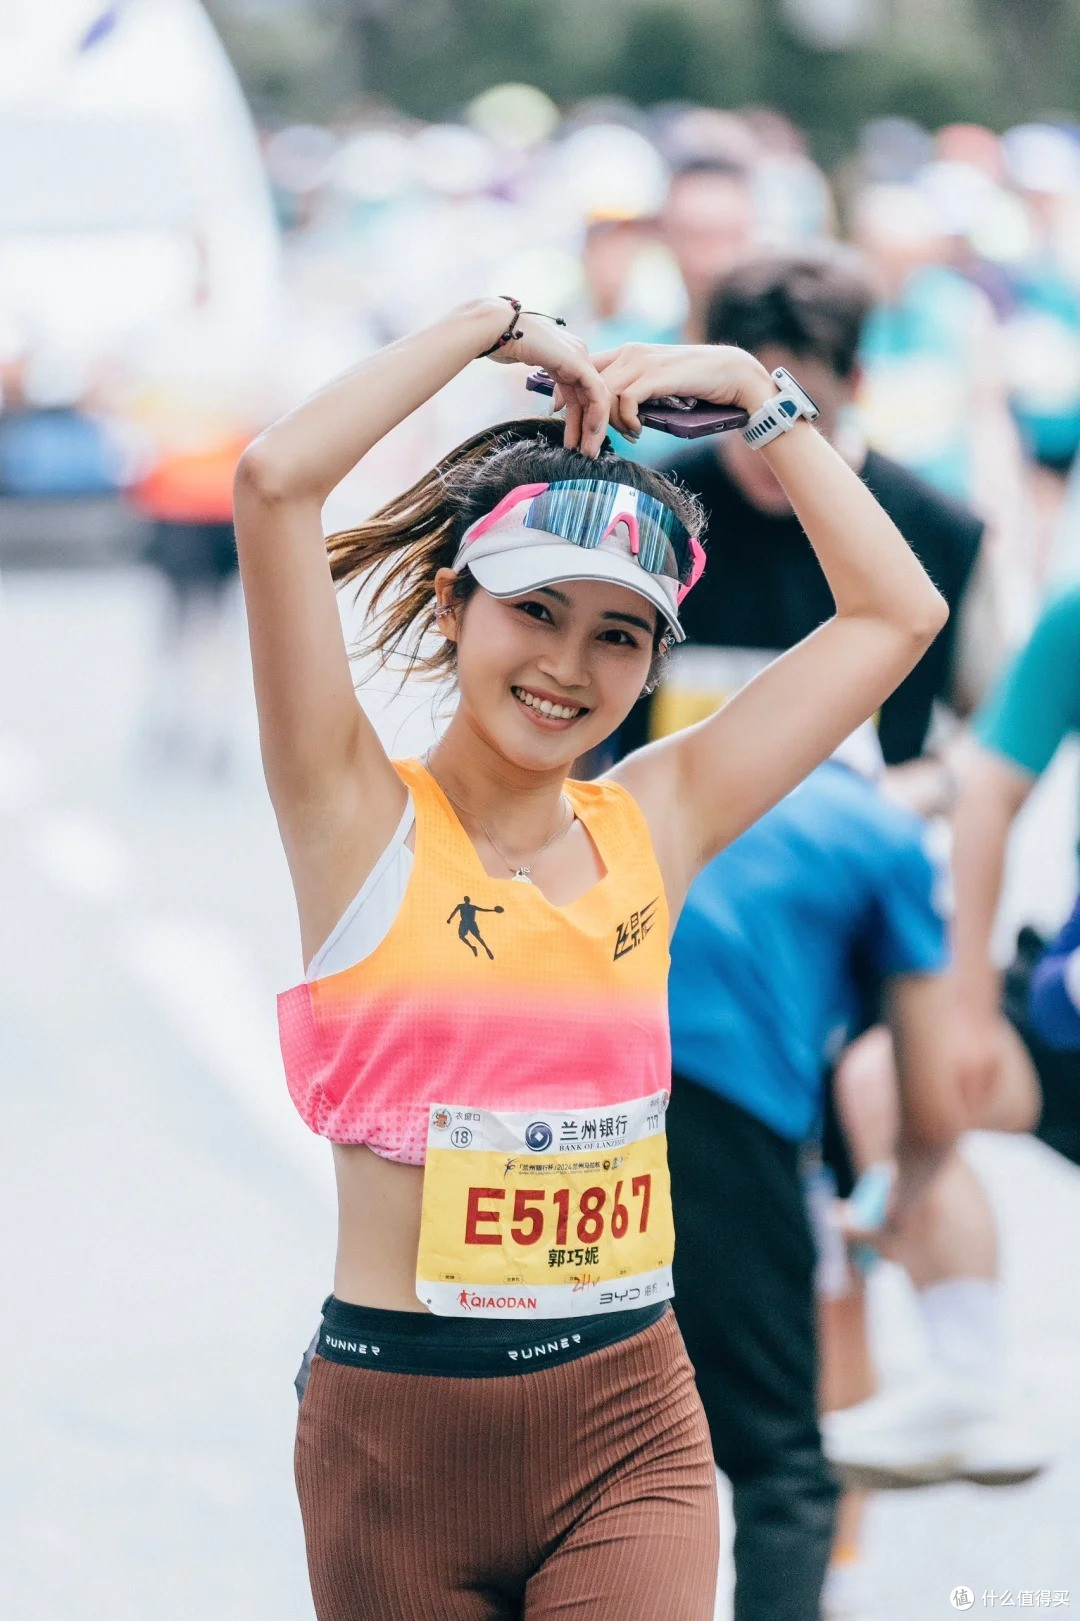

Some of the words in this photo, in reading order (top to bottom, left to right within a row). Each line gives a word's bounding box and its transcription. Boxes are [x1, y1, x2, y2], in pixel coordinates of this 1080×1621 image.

[454, 1111, 481, 1121] 衣窗口
[454, 1129, 470, 1145] 18
[560, 1115, 628, 1140] 兰州银行
[559, 1143, 582, 1152] BANK
[465, 1174, 651, 1246] E51867
[548, 1246, 600, 1268] 郭巧妮
[471, 1296, 538, 1310] QIAODAN
[599, 1287, 641, 1305] BYD
[325, 1334, 381, 1356] RUNNER
[507, 1333, 582, 1361] RUNNER
